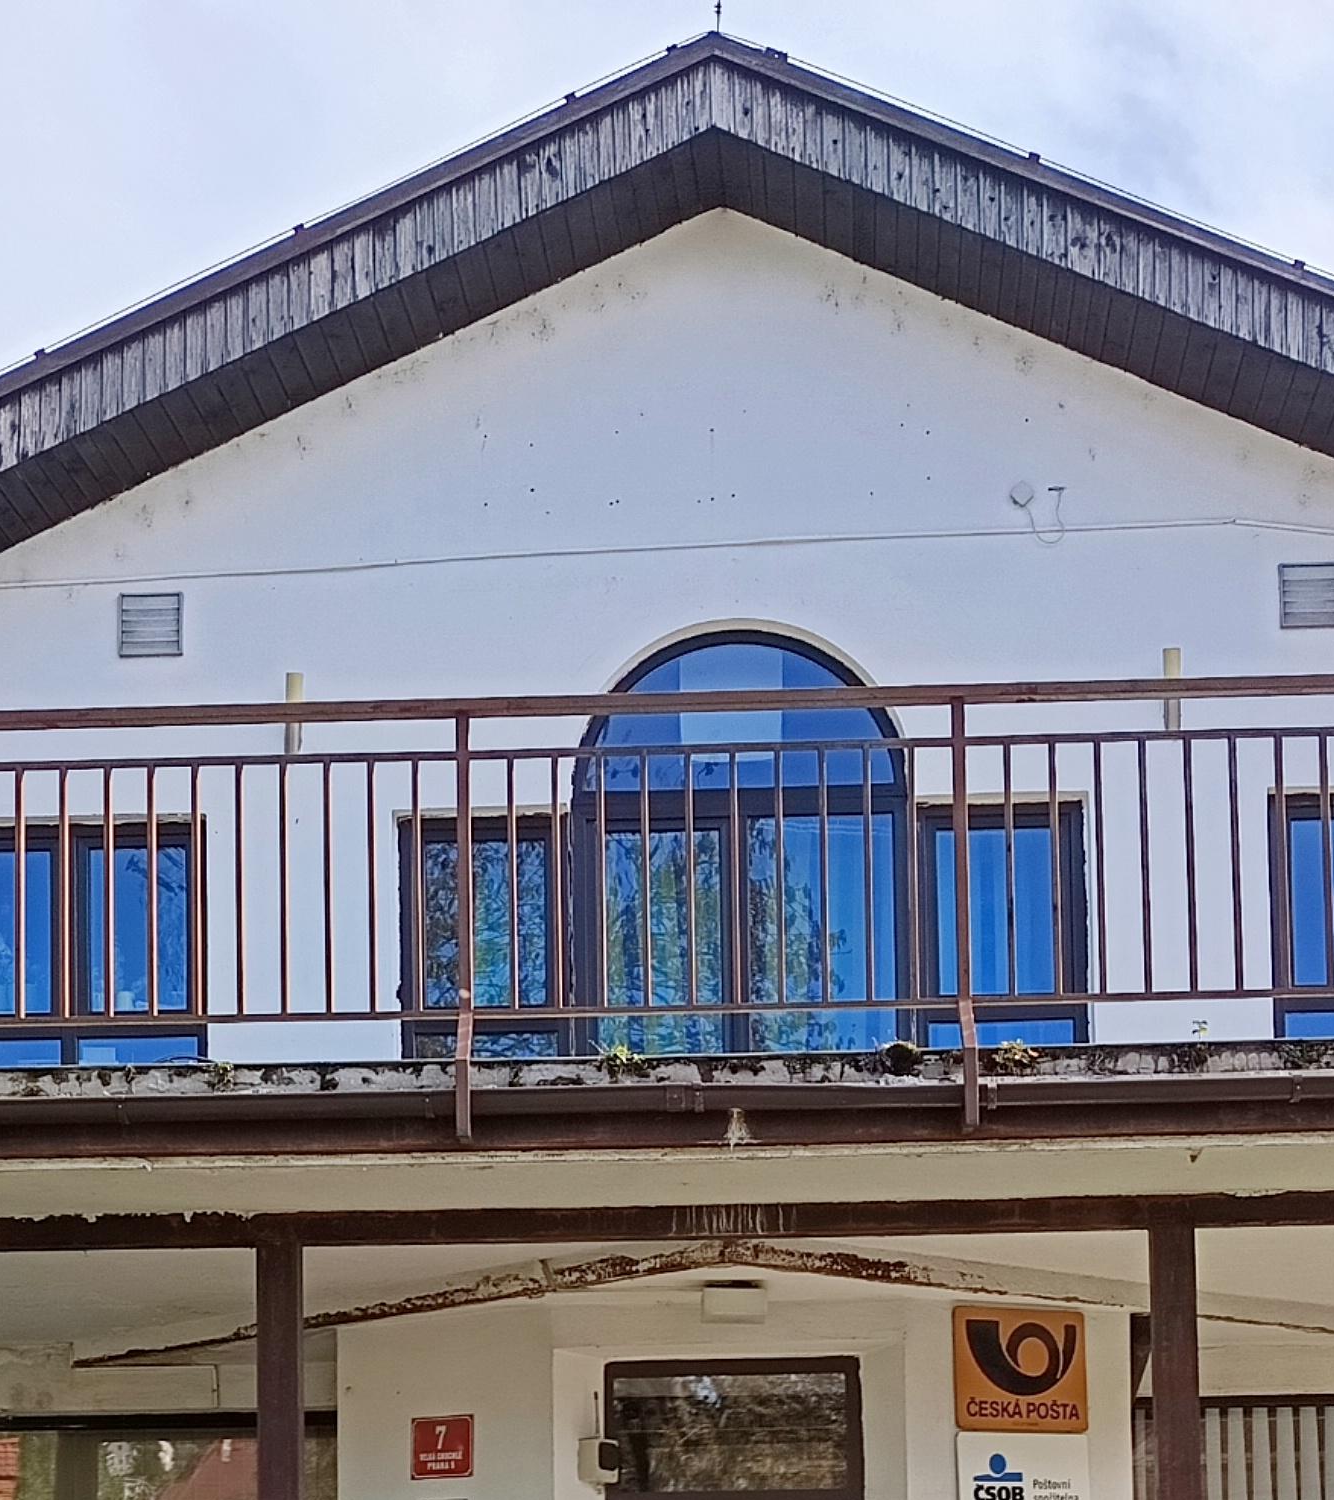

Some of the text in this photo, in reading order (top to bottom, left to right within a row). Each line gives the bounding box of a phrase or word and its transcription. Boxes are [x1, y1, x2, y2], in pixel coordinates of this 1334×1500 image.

[967, 1397, 1080, 1420] ČESKÁ POŠTA
[435, 1425, 447, 1449] 7
[1032, 1479, 1071, 1490] Poštovní
